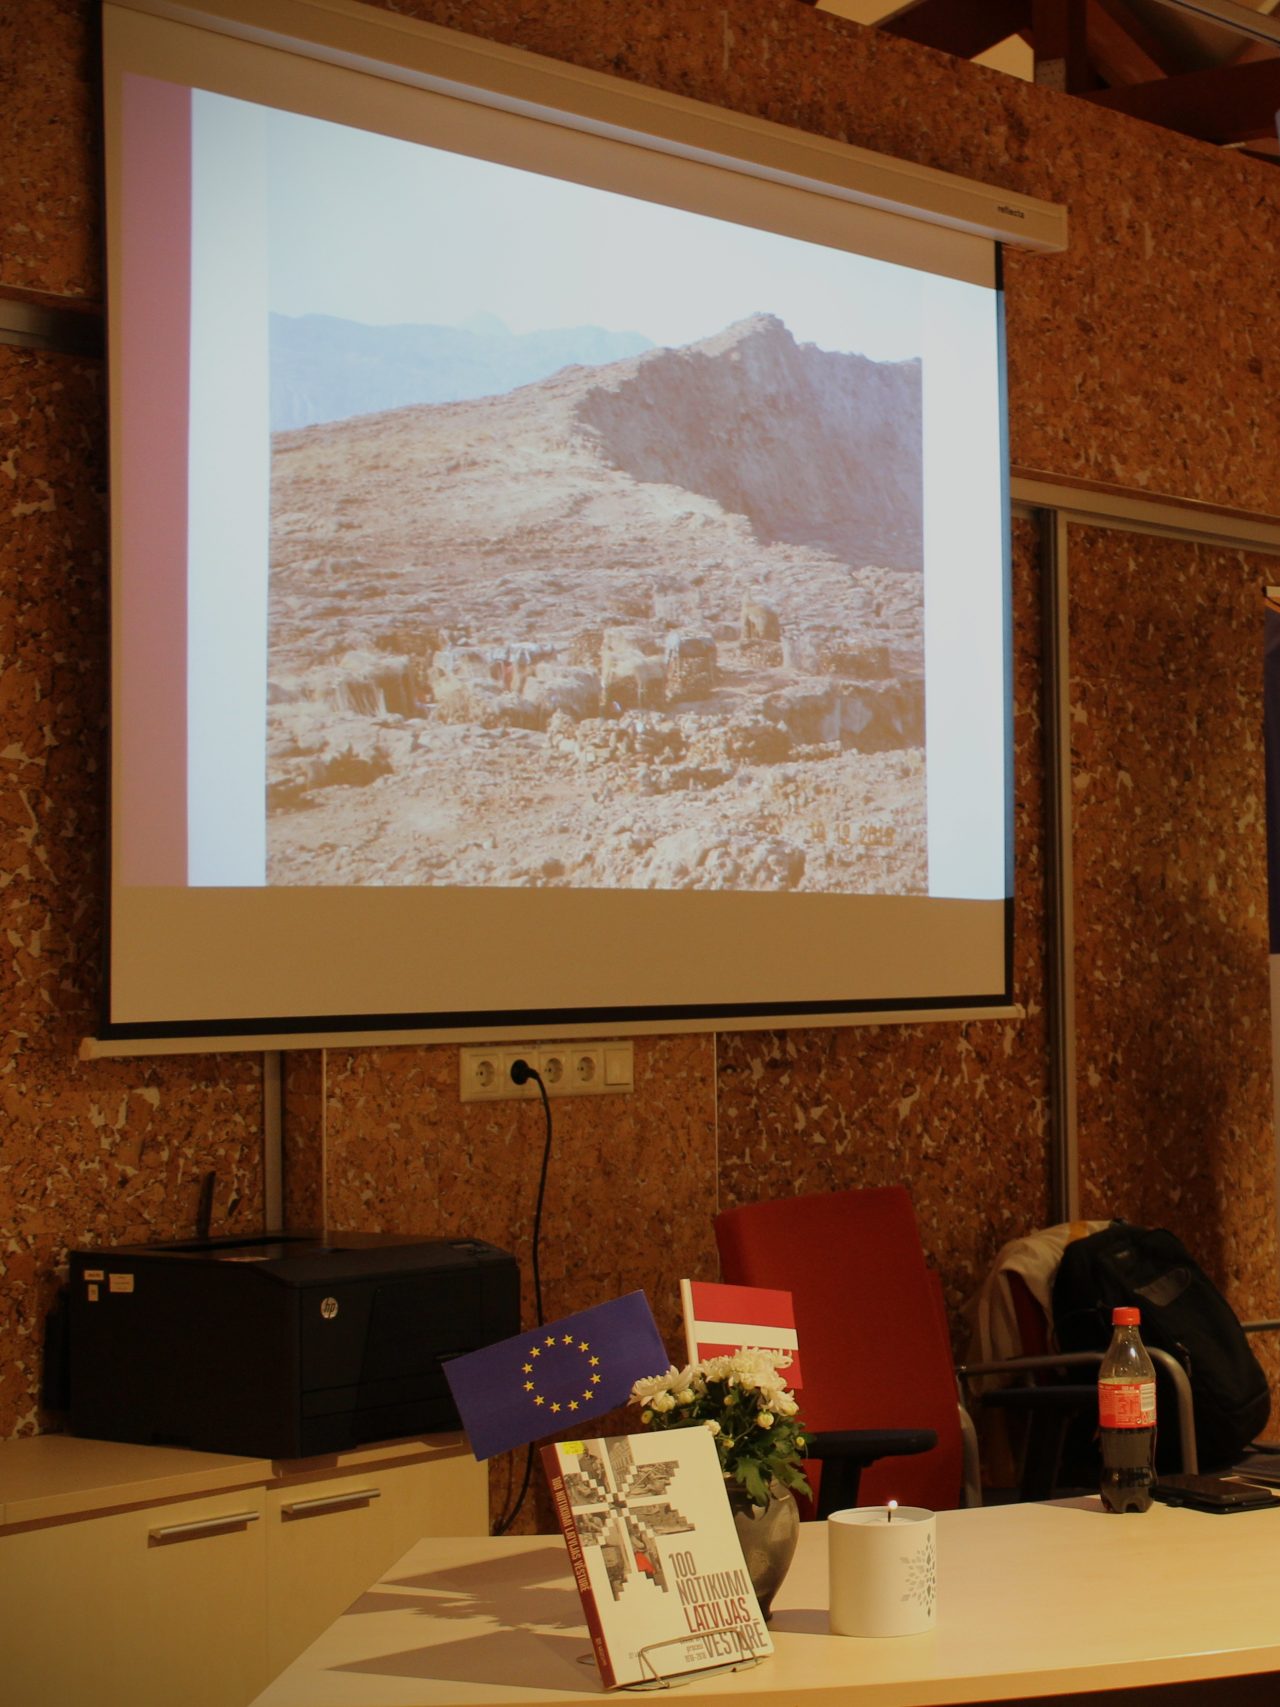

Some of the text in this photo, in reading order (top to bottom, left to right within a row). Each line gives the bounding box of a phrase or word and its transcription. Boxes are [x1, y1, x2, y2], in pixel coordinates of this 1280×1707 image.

[552, 1476, 562, 1491] 100
[555, 1490, 573, 1530] NOTIKUMI
[564, 1527, 582, 1560] LATVIJAS
[668, 1551, 697, 1578] 100
[676, 1569, 750, 1606] NOTIKUMI
[683, 1597, 751, 1633] LATVIJAS
